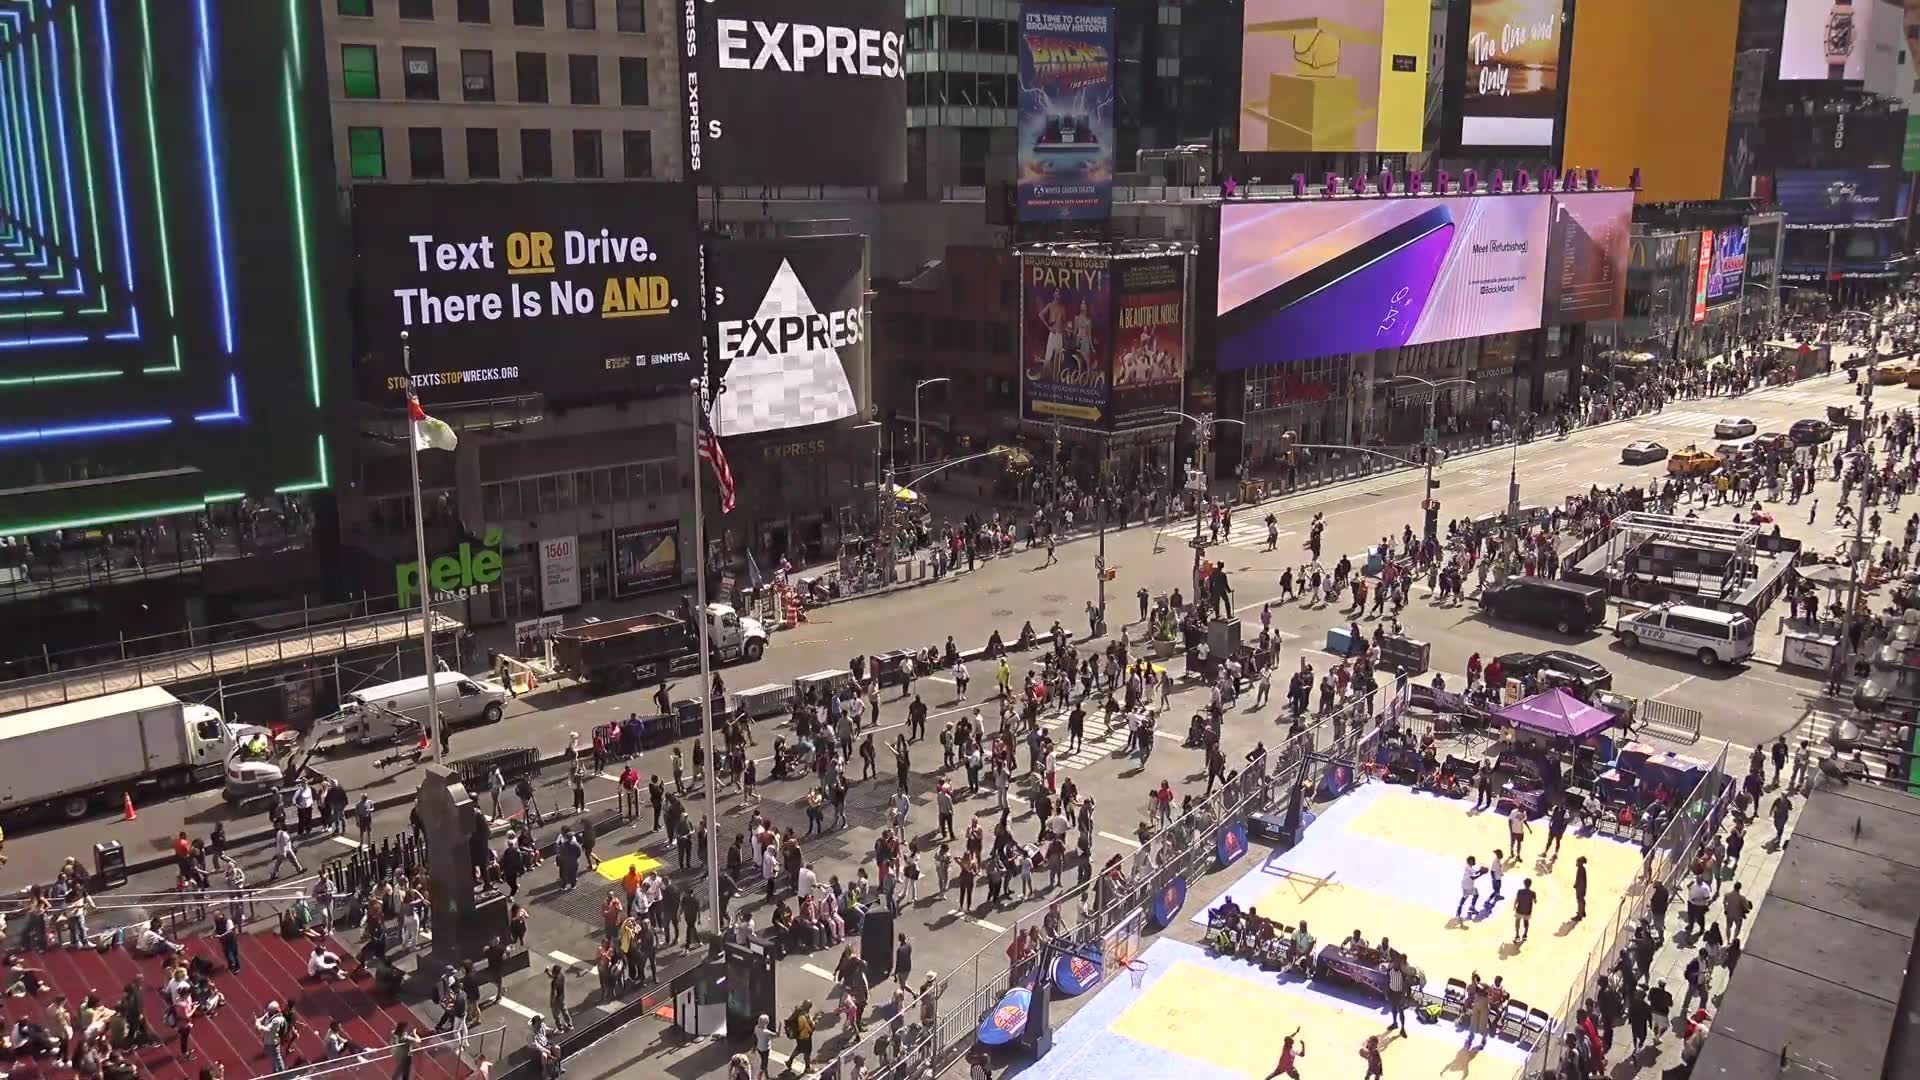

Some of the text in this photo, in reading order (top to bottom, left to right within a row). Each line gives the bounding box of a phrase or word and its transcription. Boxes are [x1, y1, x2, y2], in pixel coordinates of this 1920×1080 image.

[1026, 22, 1070, 32] BROADWAY
[717, 18, 904, 81] EXPRES
[1470, 31, 1496, 65] The
[1501, 23, 1526, 54] One
[687, 71, 701, 171] EXPRESS
[1834, 114, 1845, 149] 1500
[409, 227, 657, 272] Text OR Drive.
[1472, 241, 1527, 254] Meet Refurbished
[1075, 258, 1108, 270] BIGGEST
[1032, 267, 1102, 292] PARTY!
[394, 288, 502, 326] There
[511, 283, 542, 318] Is
[550, 280, 594, 316] No
[601, 275, 679, 315] AND.
[1125, 304, 1160, 328] BEAUTIFUL
[1160, 303, 1180, 324] NOISE
[659, 351, 691, 365] NHTSA
[544, 542, 569, 558] 1560
[1640, 627, 1666, 640] NYPD
